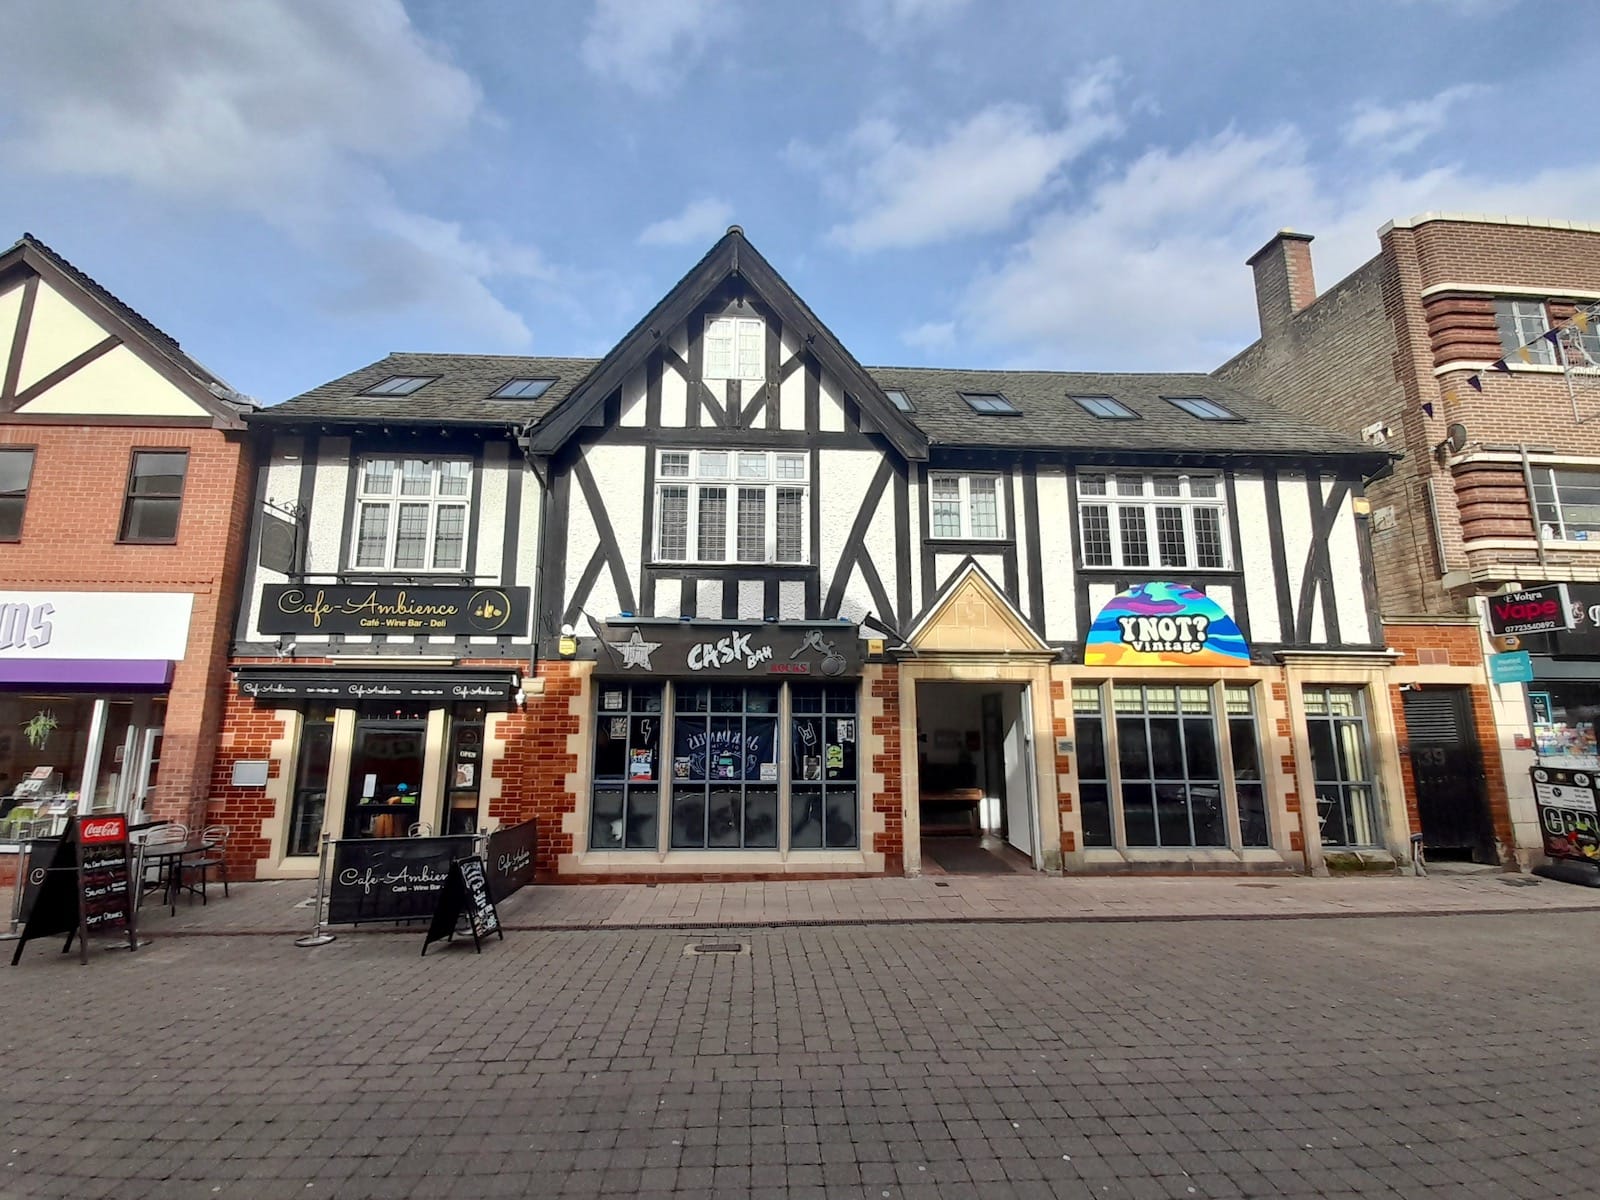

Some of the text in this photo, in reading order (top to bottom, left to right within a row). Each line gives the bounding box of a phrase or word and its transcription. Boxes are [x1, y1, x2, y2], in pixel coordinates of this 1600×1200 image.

[278, 589, 458, 627] Cafe-Ambience
[1513, 592, 1543, 601] Vohra
[360, 618, 380, 627] Café
[386, 618, 406, 627] Wine
[407, 618, 422, 627] Bar
[430, 618, 446, 627] Deli
[1119, 616, 1208, 642] YNOT?
[687, 630, 754, 670] CASK
[339, 865, 449, 894] Cafe-Ambien
